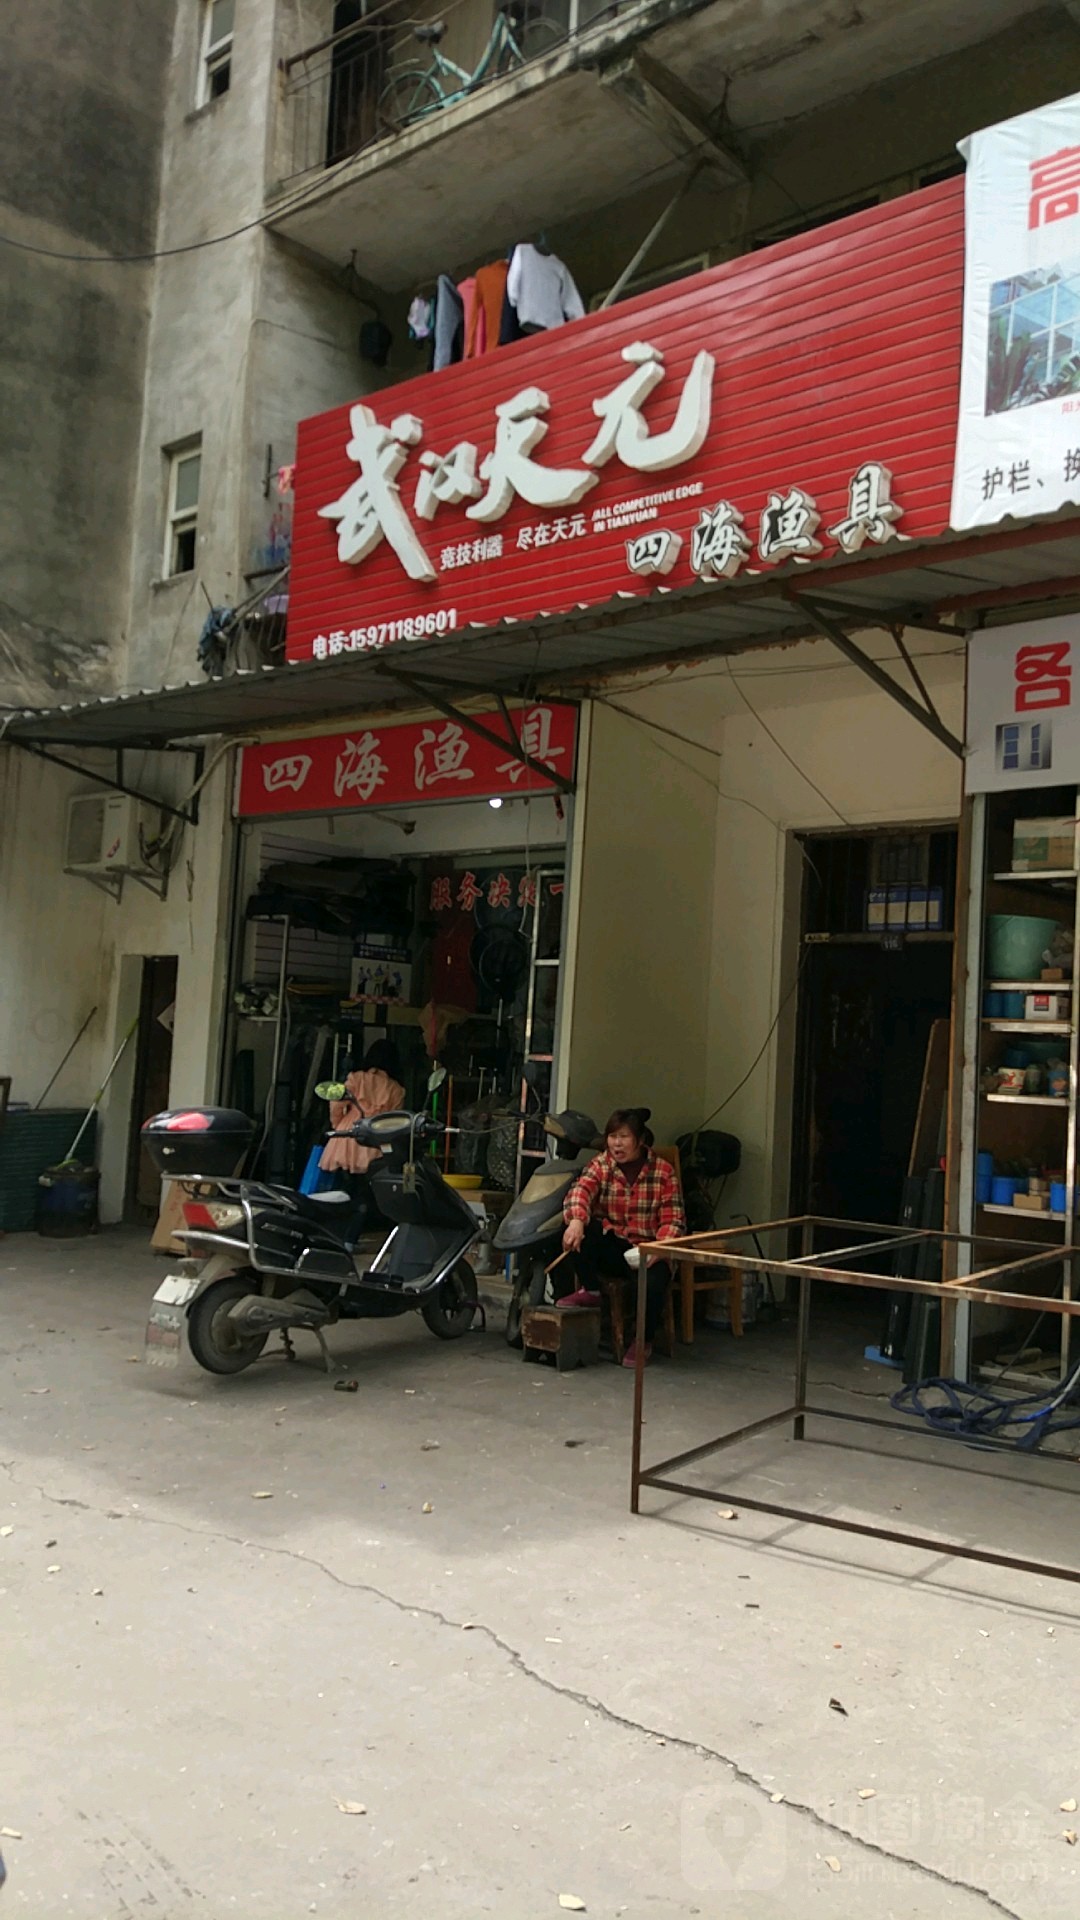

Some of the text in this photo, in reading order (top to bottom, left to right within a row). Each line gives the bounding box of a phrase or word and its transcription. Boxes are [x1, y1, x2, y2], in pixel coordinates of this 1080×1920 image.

[612, 489, 676, 516] COMPETITIVE
[675, 482, 704, 500] EDGE
[516, 513, 587, 551] 尽在天元
[593, 507, 658, 533] IN TIANYUAN
[626, 461, 904, 577] 四海渔具
[440, 533, 503, 571] 竞技利器
[262, 707, 565, 800] 四海渔具
